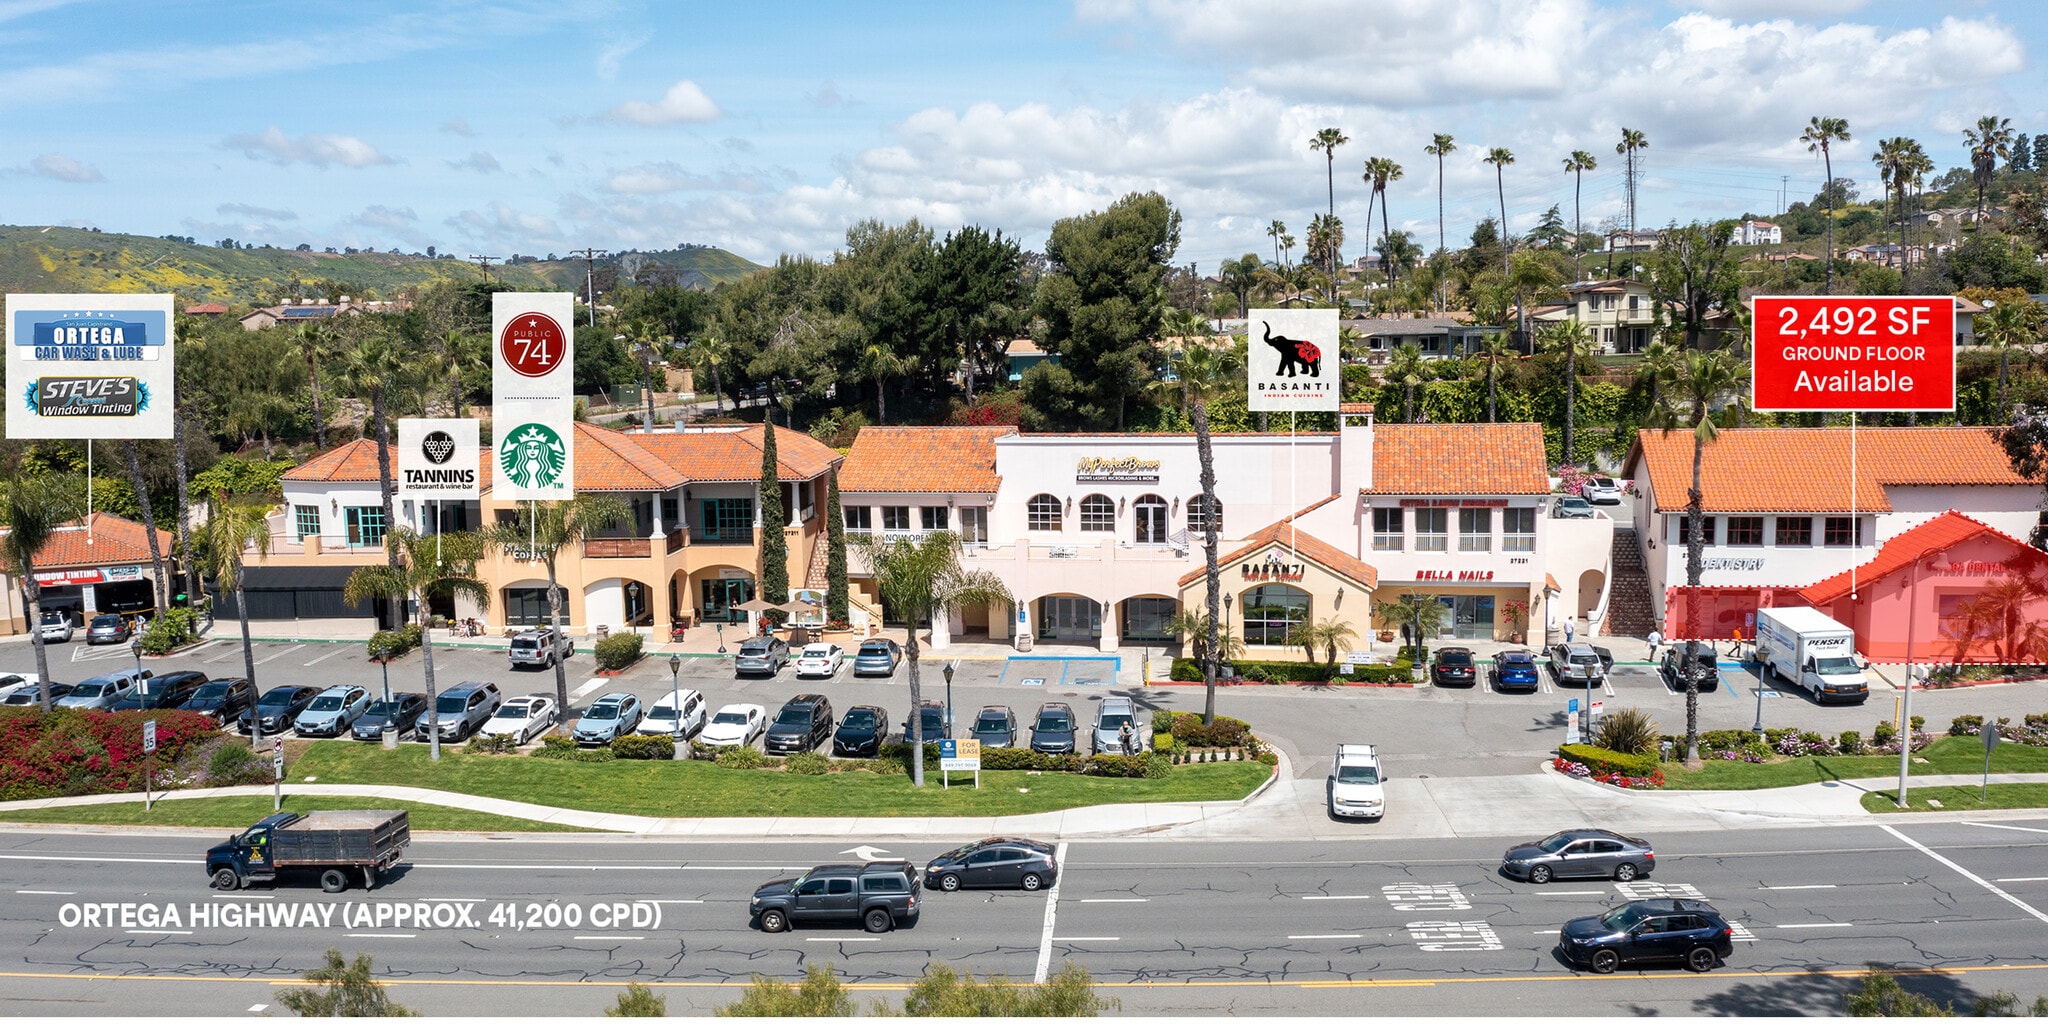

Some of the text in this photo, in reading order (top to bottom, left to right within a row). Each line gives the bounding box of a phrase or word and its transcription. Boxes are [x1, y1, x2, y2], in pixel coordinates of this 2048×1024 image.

[67, 569, 98, 580] TINTING
[1416, 570, 1494, 580] BELLA NAILS
[1808, 638, 1848, 646] PENSKE
[145, 737, 154, 749] 35
